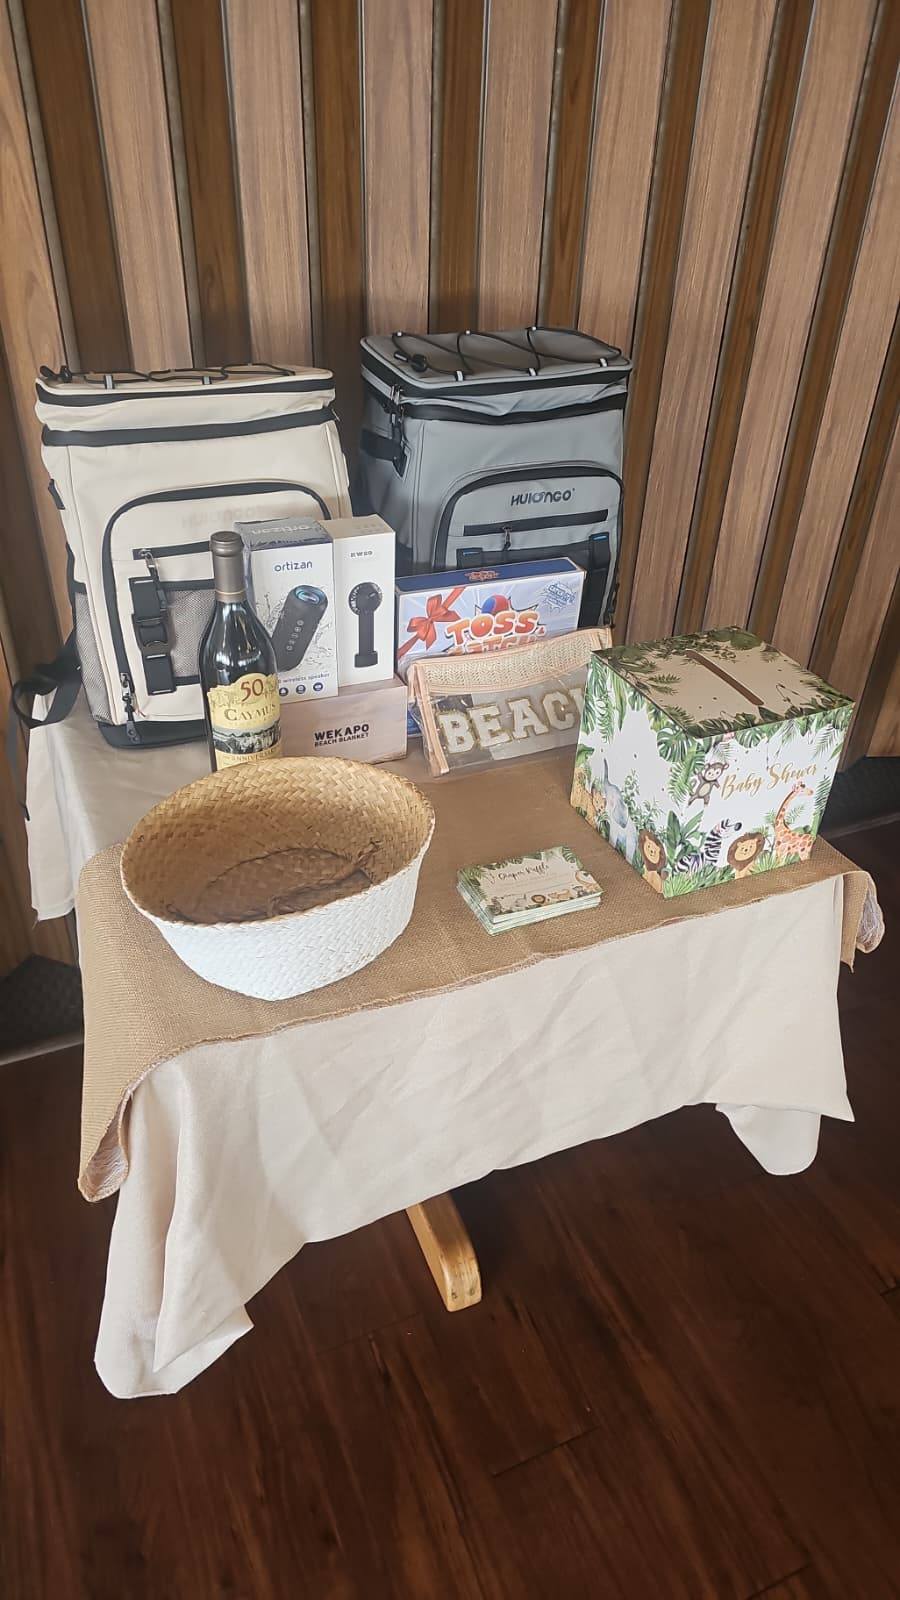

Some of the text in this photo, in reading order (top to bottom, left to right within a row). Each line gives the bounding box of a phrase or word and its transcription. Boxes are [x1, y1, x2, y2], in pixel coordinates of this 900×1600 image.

[274, 560, 313, 572] ortizan
[447, 611, 538, 645] TOSS
[240, 678, 264, 702] 50
[314, 723, 370, 741] WEKAPO
[314, 732, 370, 748] BEACH BLANKET
[721, 761, 817, 800] Baby Shower
